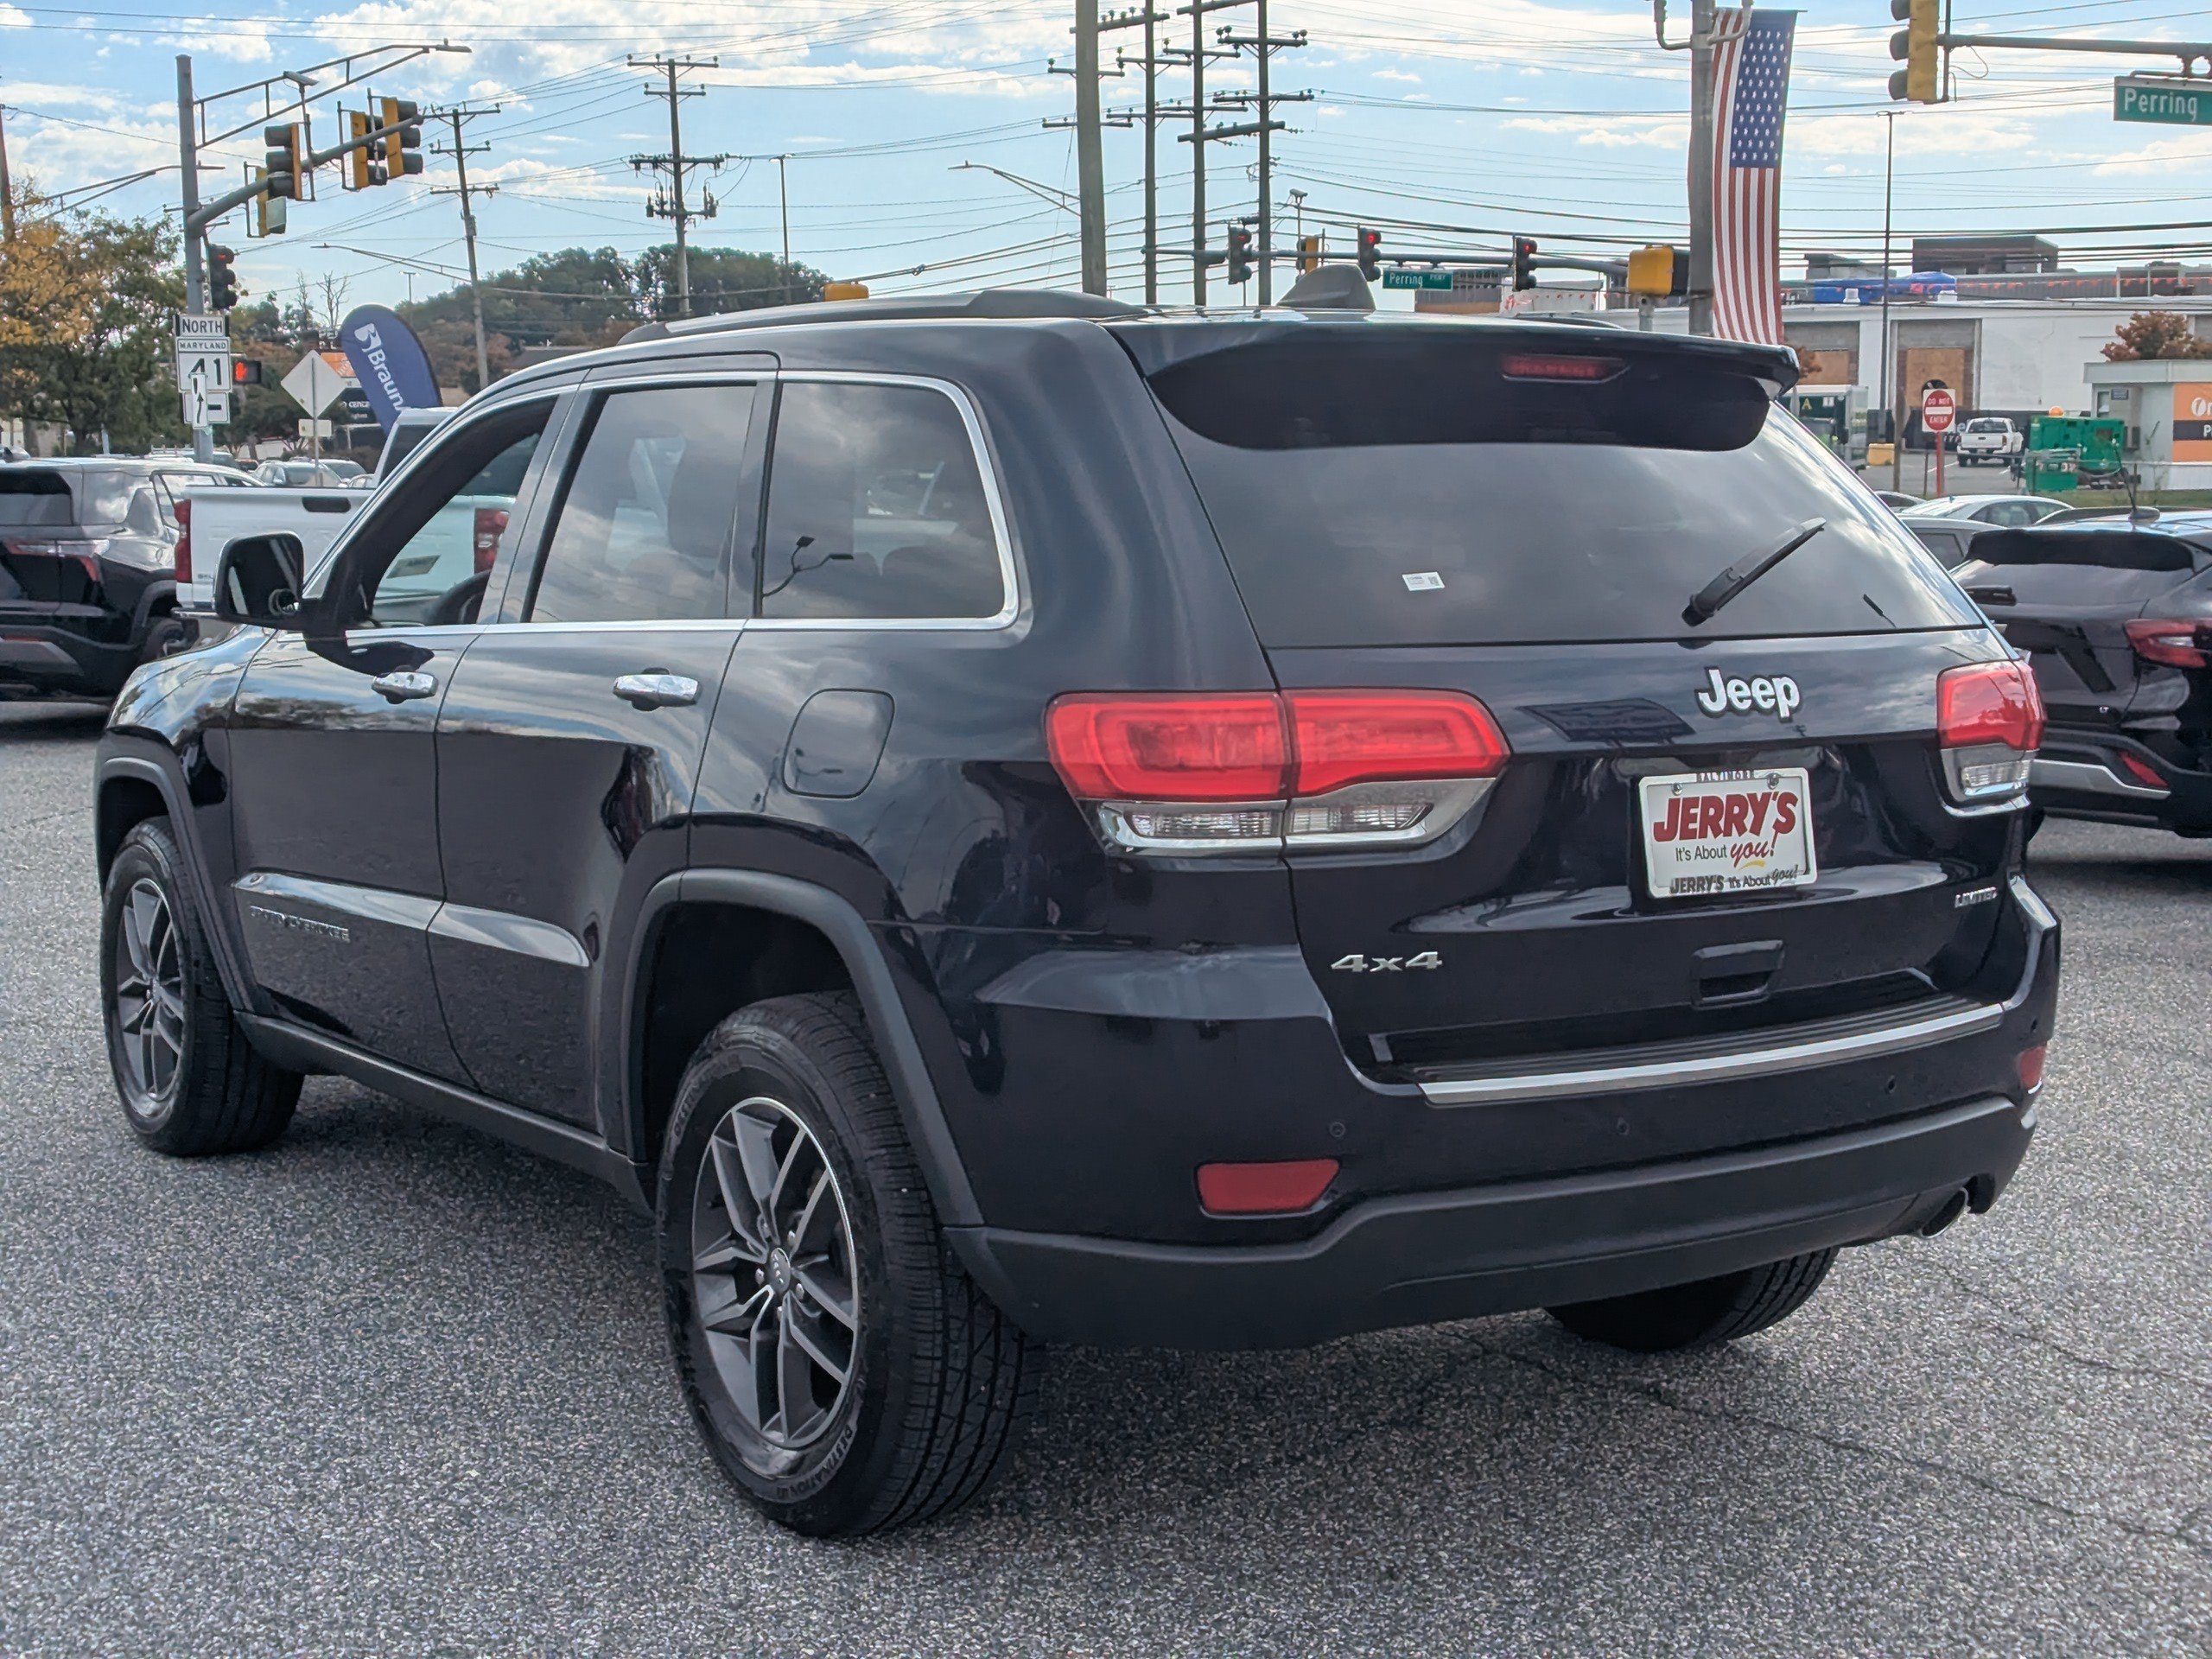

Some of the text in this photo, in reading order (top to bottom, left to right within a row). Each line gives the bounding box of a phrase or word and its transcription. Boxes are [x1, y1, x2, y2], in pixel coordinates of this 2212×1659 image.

[2124, 87, 2198, 122] Perring
[1389, 272, 1424, 288] Perring
[181, 318, 224, 334] NORTH
[180, 341, 227, 350] MARYLAND
[188, 358, 222, 386] 41
[1696, 667, 1802, 721] Jeep
[1652, 791, 1799, 842] JERRY'S
[1675, 833, 1778, 868] It's About you!
[1669, 874, 1725, 893] JERRY'S
[1743, 873, 1772, 888] About
[1331, 950, 1443, 973] 4x4
